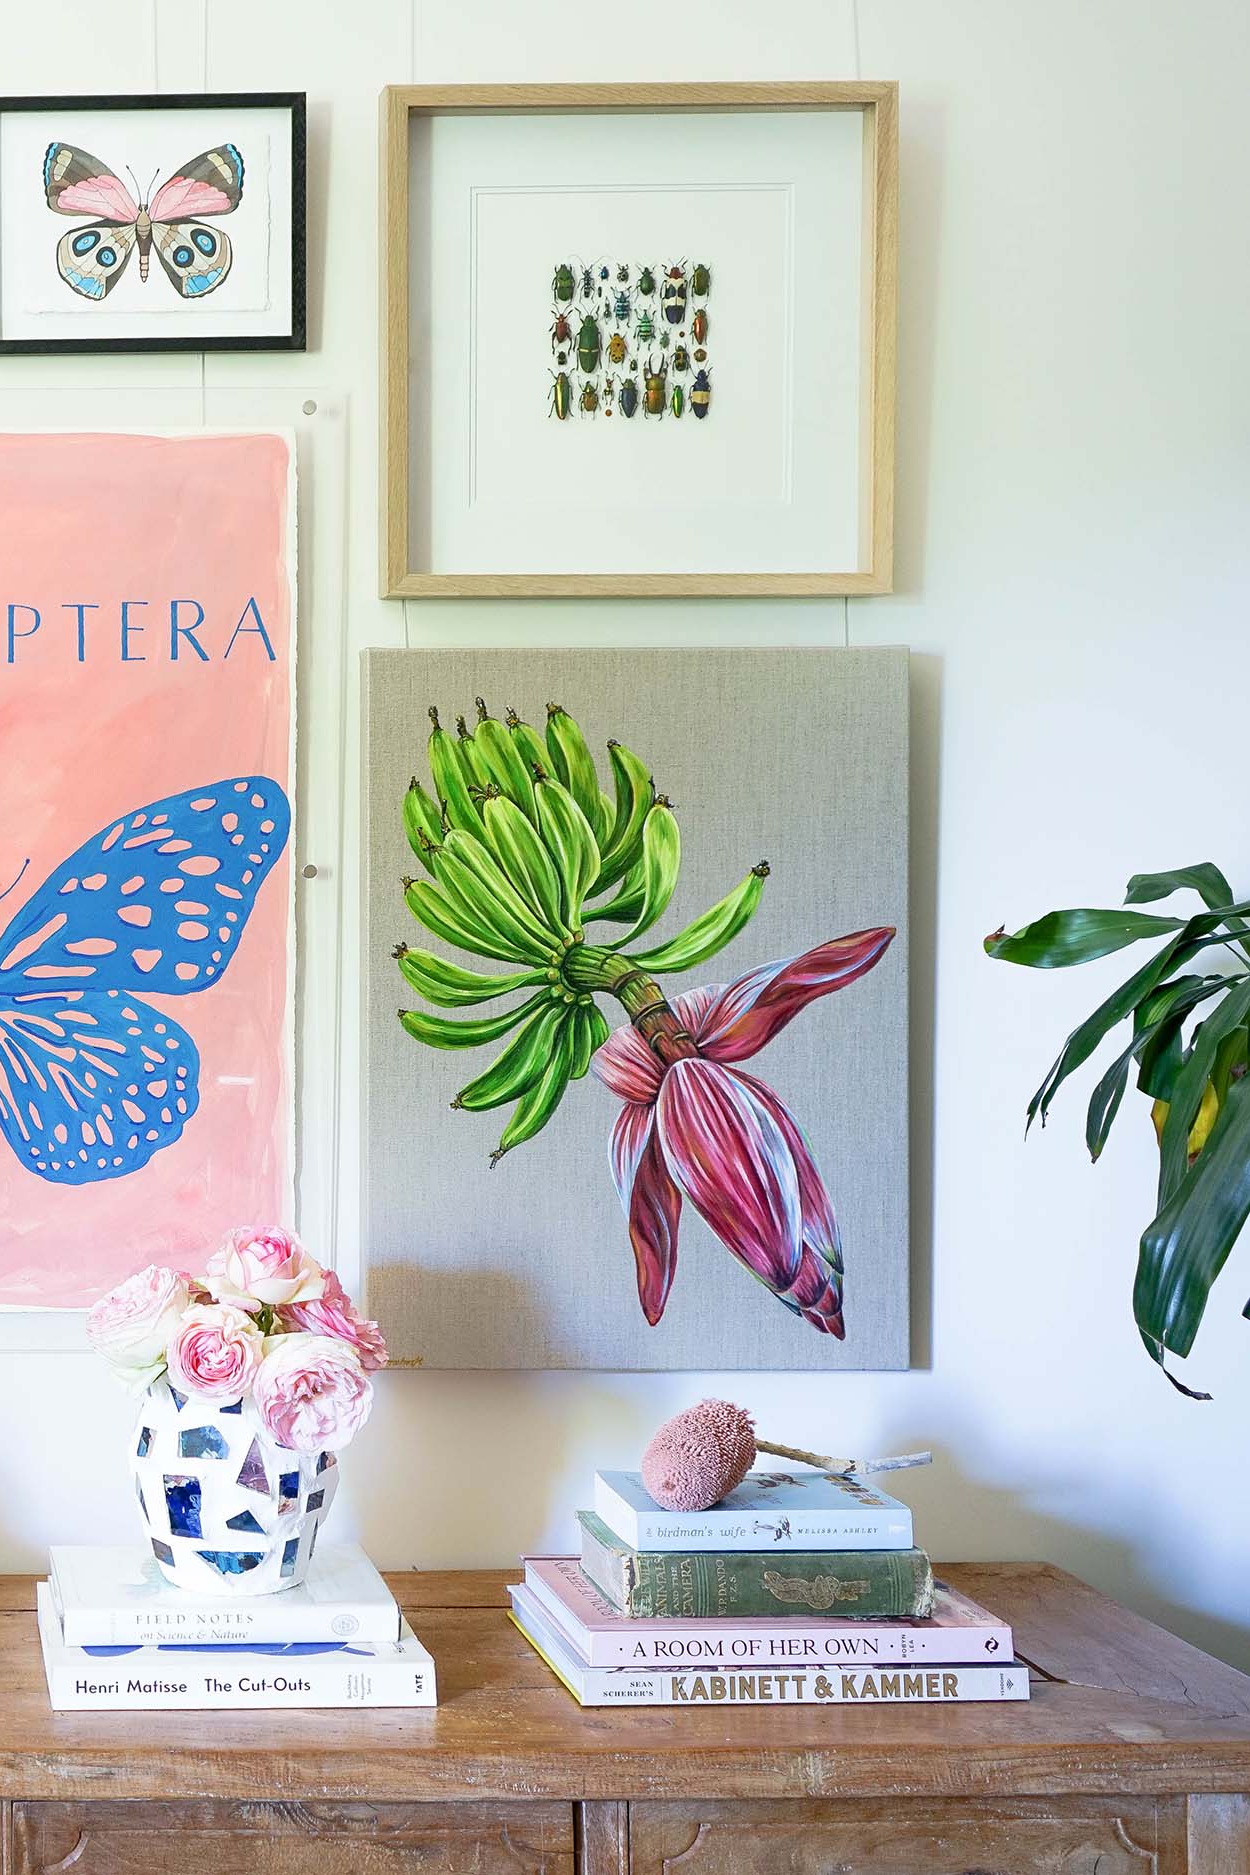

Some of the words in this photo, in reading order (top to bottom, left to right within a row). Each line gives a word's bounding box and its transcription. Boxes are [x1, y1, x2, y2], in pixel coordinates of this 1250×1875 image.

[657, 1525, 713, 1538] birdman's
[719, 1526, 746, 1540] wife
[670, 1566, 679, 1586] THE
[653, 1555, 668, 1617] ANIMALS
[680, 1558, 694, 1617] CAMERA
[671, 1589, 681, 1611] AND
[135, 1614, 186, 1625] FIELD
[196, 1613, 254, 1624] NOTES
[140, 1632, 153, 1640] on
[156, 1630, 194, 1640] Science
[196, 1630, 207, 1640] &
[210, 1629, 248, 1640] Nature
[633, 1641, 647, 1657] A
[654, 1640, 723, 1657] ROOM
[731, 1639, 763, 1656] OF
[769, 1639, 818, 1656] HER
[825, 1638, 879, 1655] OWN
[75, 1680, 119, 1695] Henri
[127, 1679, 188, 1693] Matisse
[205, 1678, 232, 1692] The
[238, 1677, 311, 1692] Cut-Outs
[414, 1674, 424, 1694] TATE
[671, 1675, 807, 1701] KABINETT
[814, 1674, 834, 1699] &
[841, 1673, 959, 1699] KAMMER
